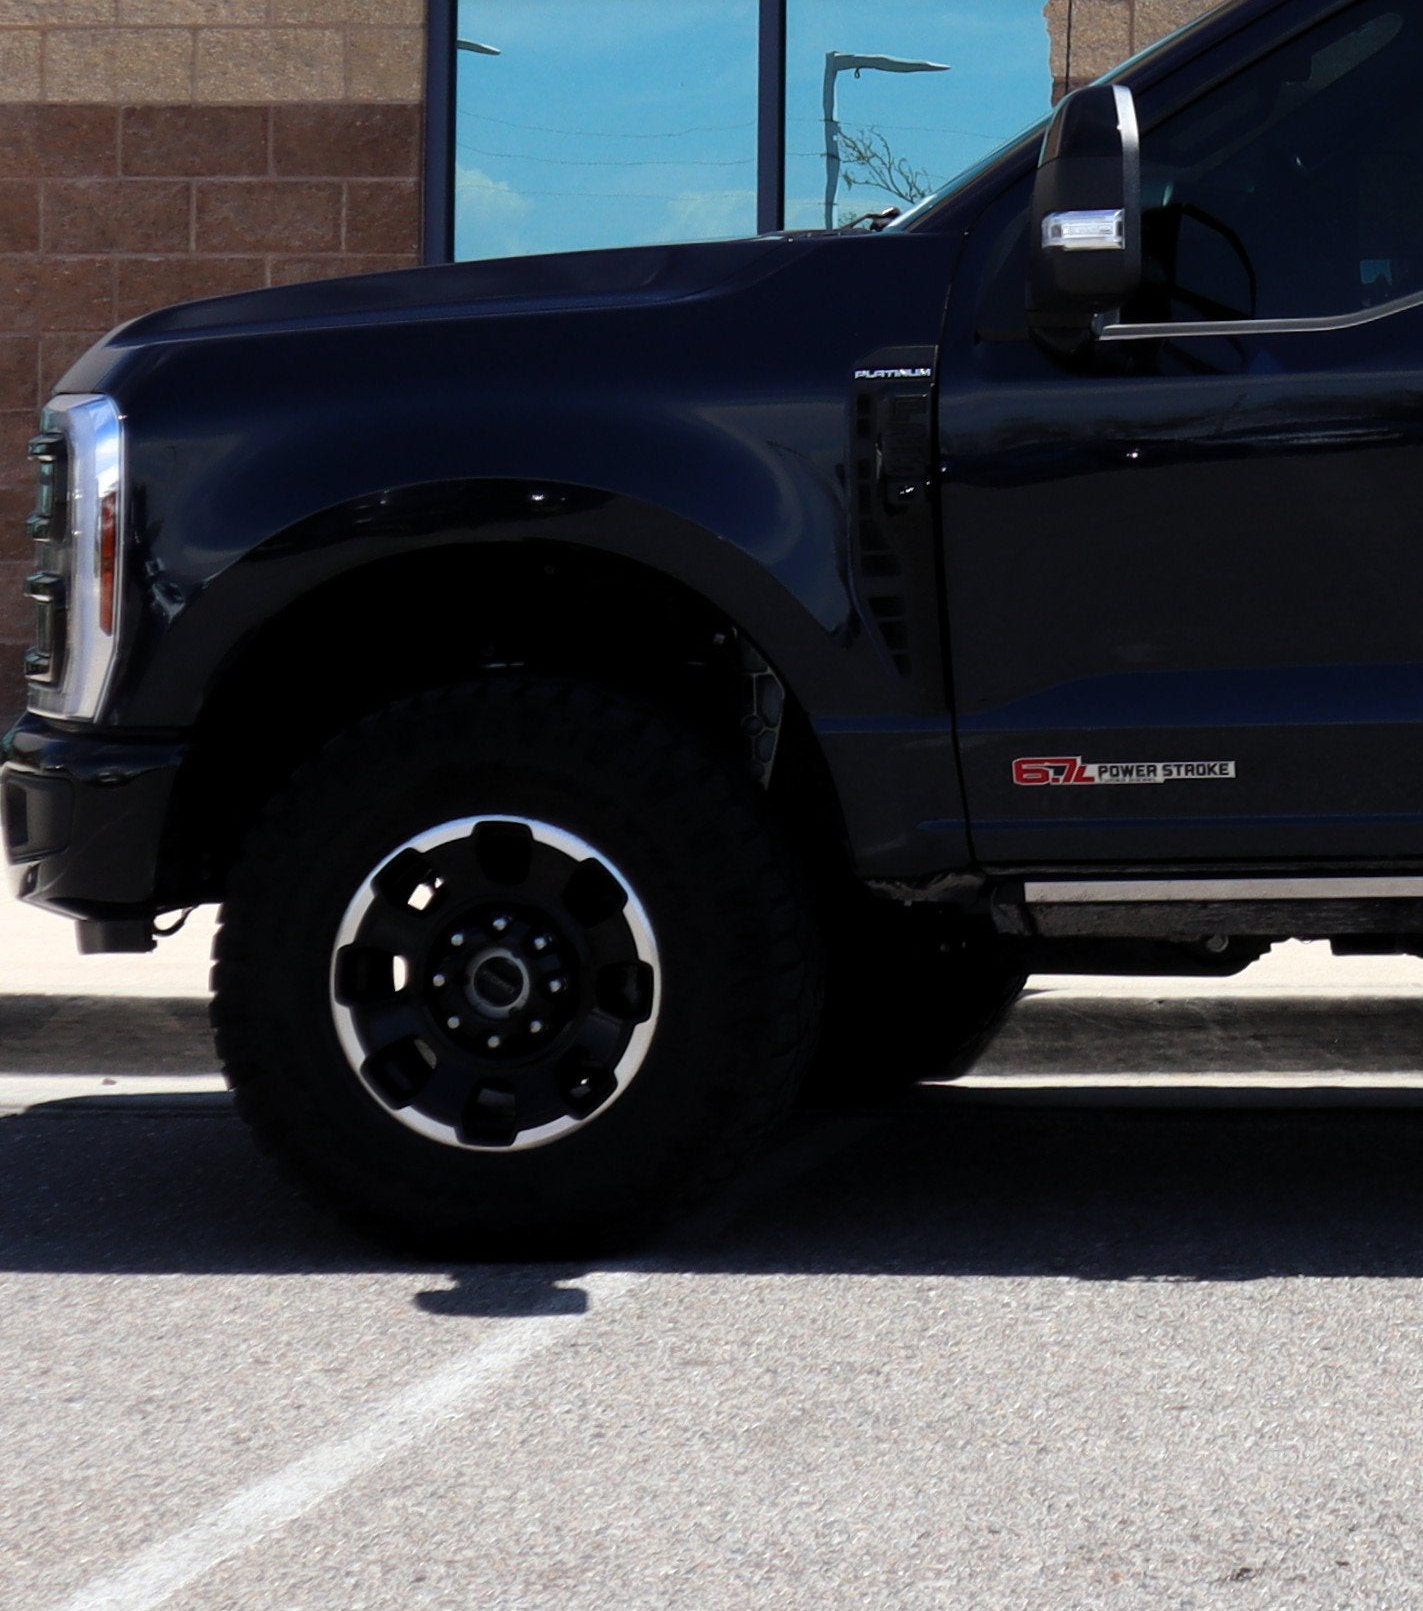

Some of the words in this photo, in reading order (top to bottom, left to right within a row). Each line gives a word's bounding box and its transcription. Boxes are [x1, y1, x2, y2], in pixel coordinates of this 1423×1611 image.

[854, 368, 931, 379] PLATINUM
[1013, 757, 1096, 784] 6.7L
[1099, 764, 1157, 777] POWER
[1162, 763, 1229, 777] STROKE
